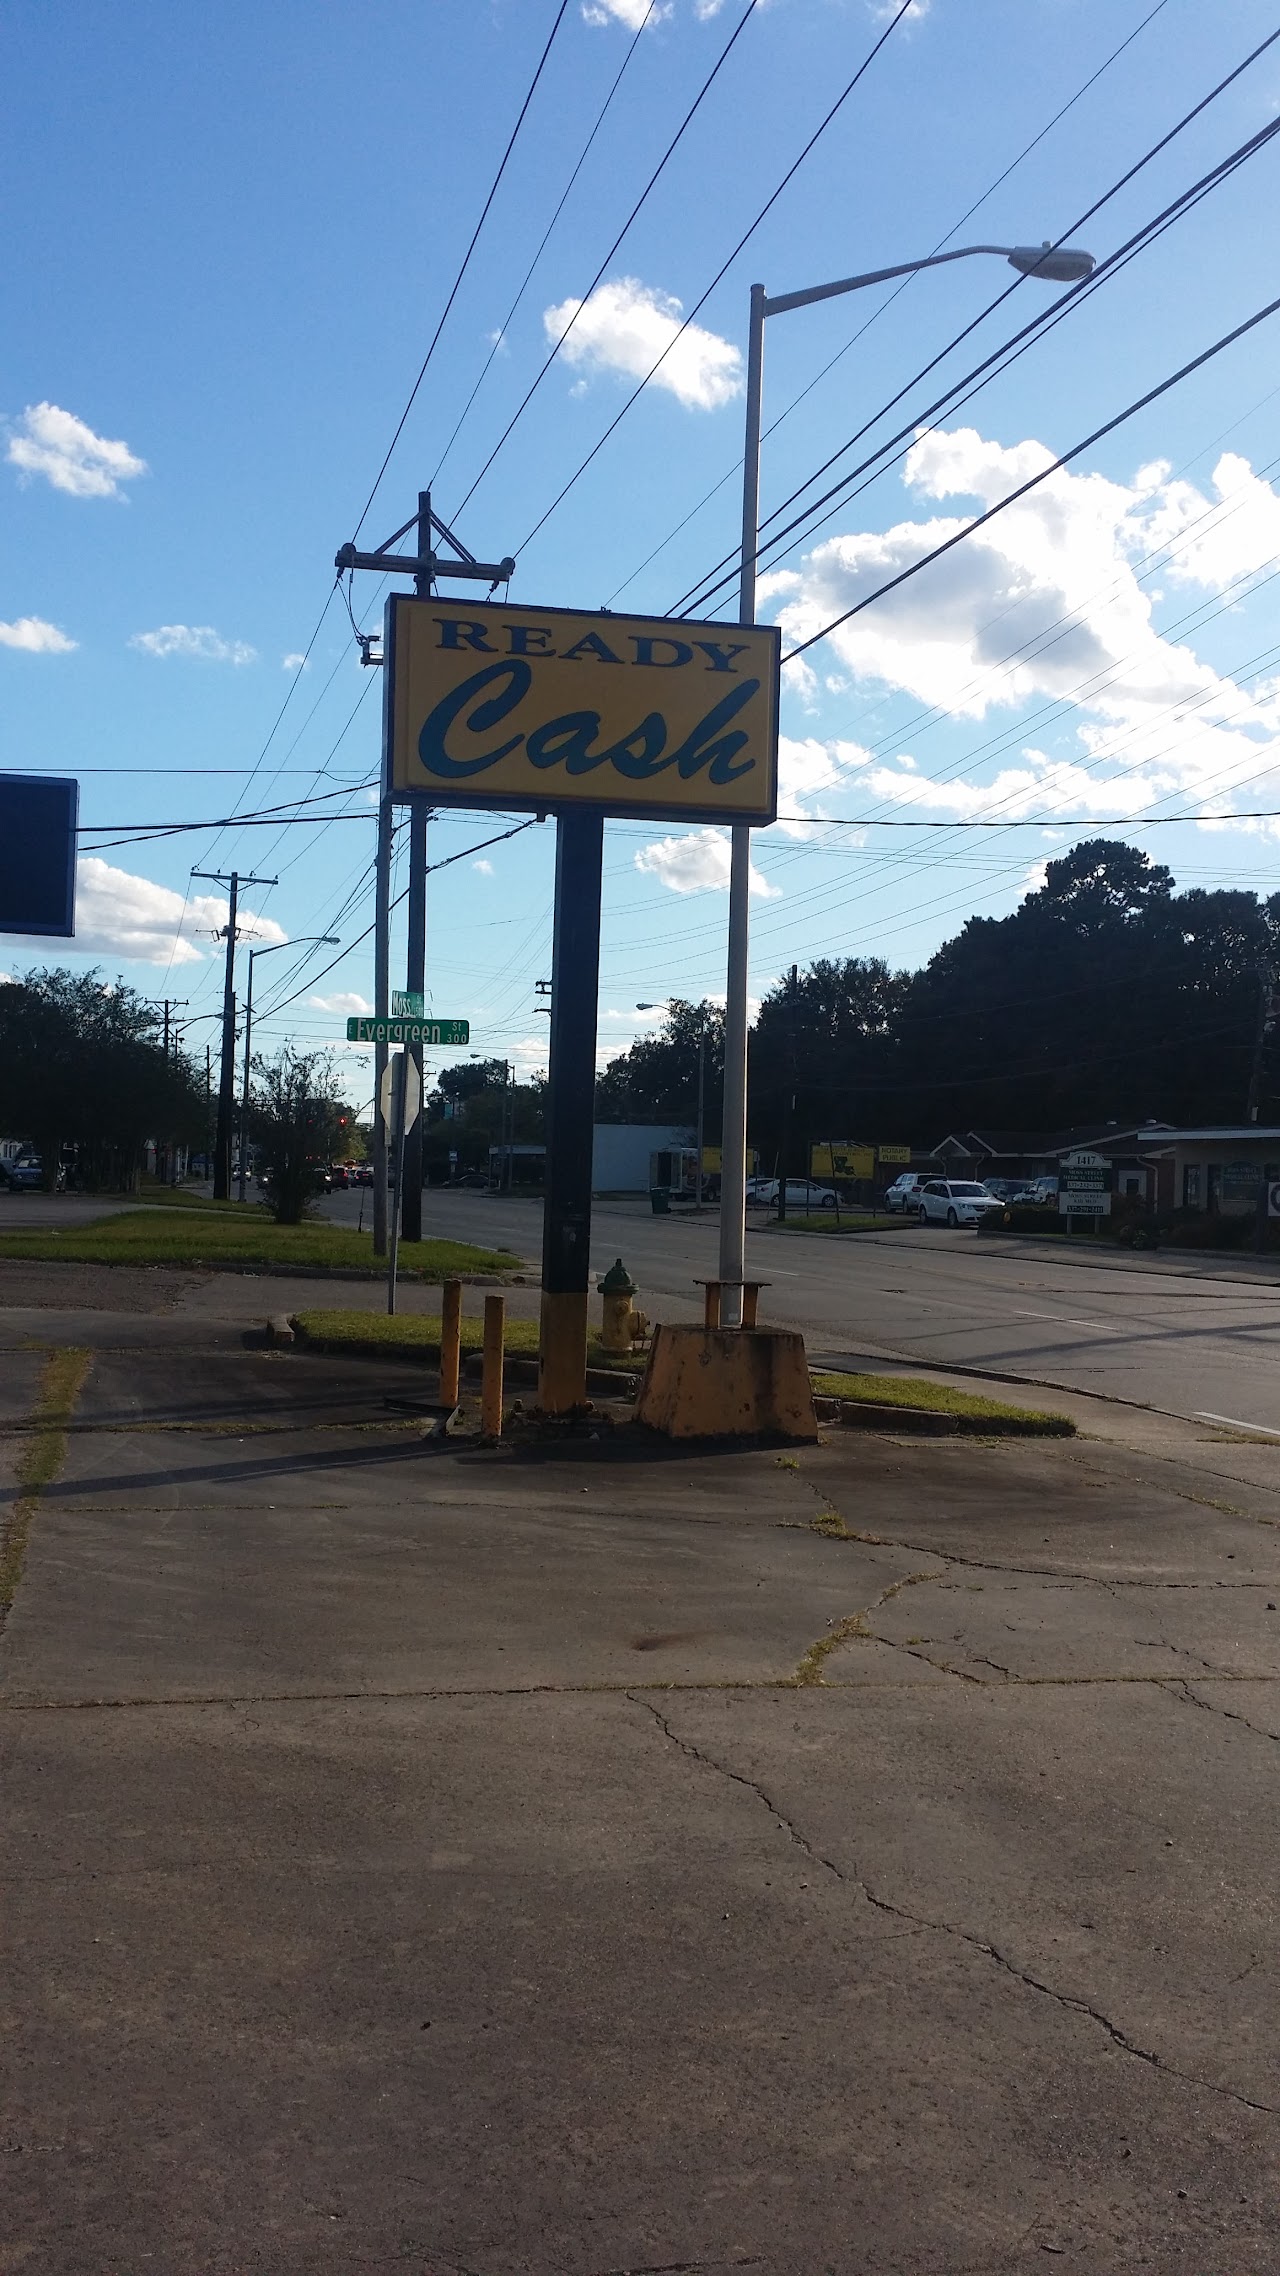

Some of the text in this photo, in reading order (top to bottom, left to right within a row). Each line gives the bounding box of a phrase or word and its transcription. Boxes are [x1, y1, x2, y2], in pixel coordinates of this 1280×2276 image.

[432, 617, 751, 673] READY
[418, 658, 760, 785] Cash
[392, 991, 411, 1016] Moss
[348, 1018, 462, 1044] E Evergreen St
[447, 1034, 467, 1044] 300
[881, 1147, 908, 1155] NOTARY
[882, 1154, 907, 1162] PUBLIC
[1077, 1156, 1096, 1165] 1417
